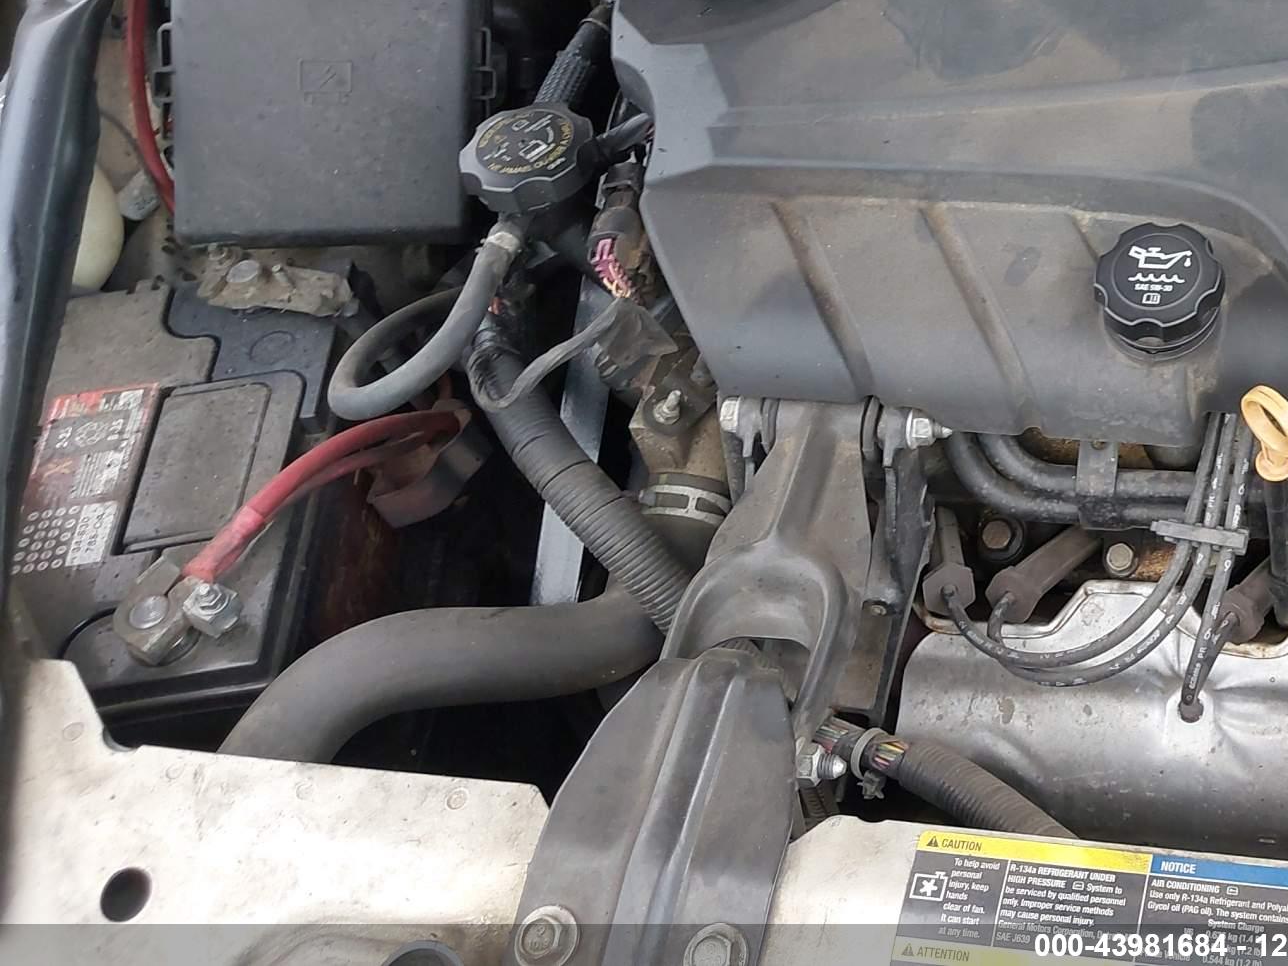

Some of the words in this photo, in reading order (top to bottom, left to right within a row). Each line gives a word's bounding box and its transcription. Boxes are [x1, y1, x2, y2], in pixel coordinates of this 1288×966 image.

[942, 838, 982, 852] CAUTION
[954, 858, 963, 866] To
[964, 859, 980, 868] help
[980, 862, 1000, 870] avoid
[1160, 860, 1197, 874] NOTICE
[950, 870, 983, 880] personal
[1010, 864, 1036, 874] R-134a
[1038, 867, 1089, 880] REFRIGERANT
[1089, 872, 1116, 883] UNDER
[948, 880, 970, 890] injury,
[971, 882, 989, 892] keep
[1008, 875, 1026, 884] HIGH
[1026, 876, 1067, 888] PRESSURE
[1086, 883, 1114, 894] System
[1115, 886, 1123, 894] to
[1151, 879, 1165, 888] AIR
[1166, 880, 1220, 893] CONDITIONING
[946, 891, 968, 900] hands
[1005, 886, 1015, 894] be
[1015, 887, 1046, 897] serviced
[1048, 890, 1057, 900] by
[1058, 892, 1089, 902] qualified
[1089, 895, 1126, 906] personnel
[1149, 890, 1163, 898] Use
[1164, 892, 1180, 901] only
[1182, 893, 1208, 904] R-134a
[1210, 896, 1250, 909] Refrigerant
[1251, 901, 1266, 910] and
[943, 903, 961, 912] clear
[962, 904, 971, 912] of
[972, 905, 985, 914] fan.
[1002, 898, 1019, 908] only.
[1020, 899, 1054, 910] Improper
[1055, 903, 1081, 912] service
[1082, 906, 1114, 916] methods
[1148, 901, 1170, 911] Glycol
[1171, 904, 1180, 912] oil
[1181, 905, 1199, 914] (PAG
[1216, 908, 1229, 917] The
[1230, 910, 1257, 920] system
[940, 914, 947, 922] It
[947, 916, 960, 924] can
[962, 917, 980, 926] start
[1000, 909, 1015, 918] may
[1017, 911, 1039, 919] cause
[1040, 914, 1071, 924] personal
[1072, 916, 1094, 926] injury.
[998, 920, 1026, 931] General
[1026, 923, 1052, 934] Motors
[1208, 918, 1236, 929] System
[1237, 922, 1264, 933] Charge
[947, 928, 961, 938] any
[962, 928, 980, 938] time.
[996, 932, 1010, 942] SAE
[1228, 933, 1238, 943] kg
[916, 946, 970, 962] ATTENTION
